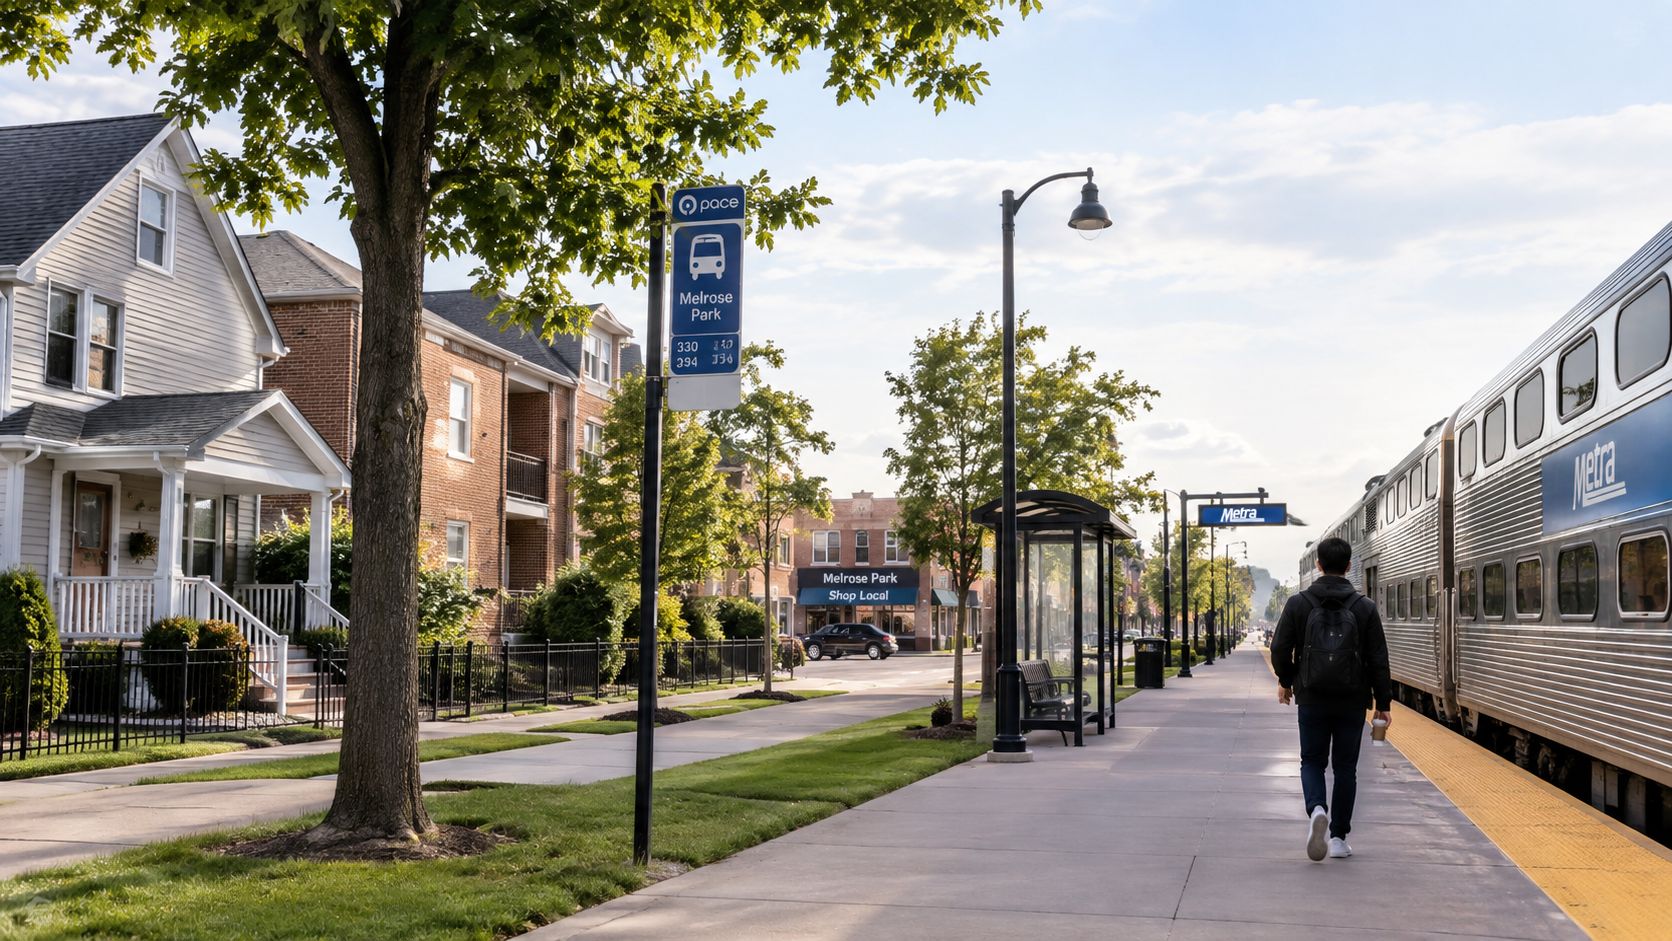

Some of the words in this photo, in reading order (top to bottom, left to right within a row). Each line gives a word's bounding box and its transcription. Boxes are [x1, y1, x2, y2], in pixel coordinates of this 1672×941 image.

[700, 197, 739, 213] pace
[680, 291, 733, 305] Melrose
[691, 307, 721, 321] Park
[677, 341, 698, 352] 330
[1572, 440, 1626, 511] Metra
[1220, 507, 1264, 522] Metra
[823, 572, 868, 583] Melrose
[871, 572, 898, 583] Park
[828, 590, 857, 603] Shop
[860, 590, 889, 600] Local
